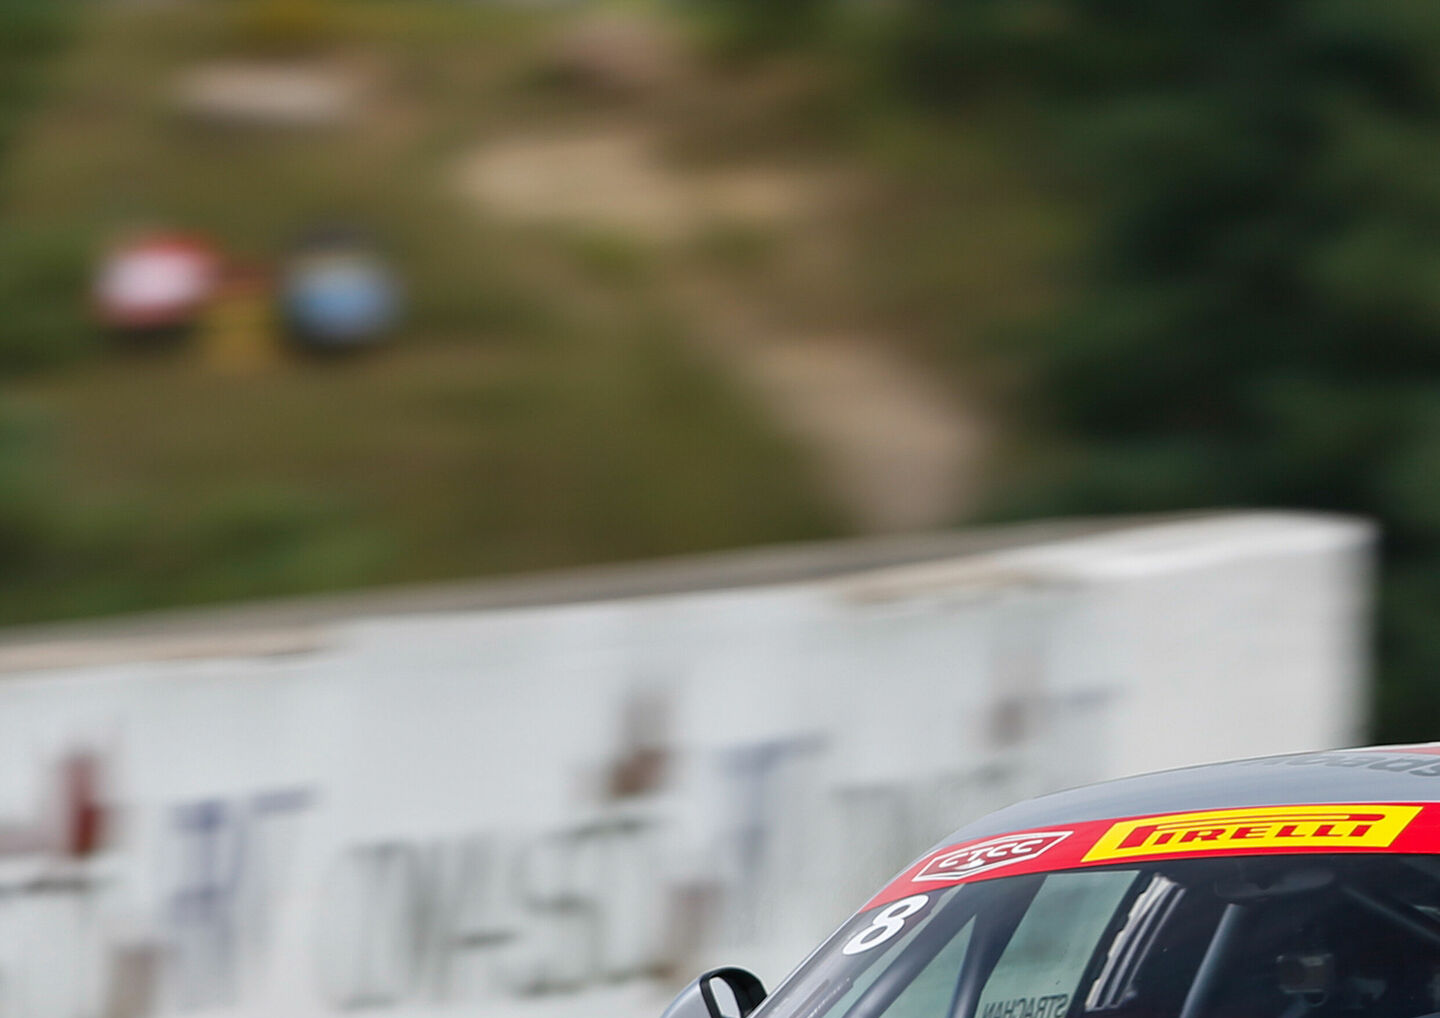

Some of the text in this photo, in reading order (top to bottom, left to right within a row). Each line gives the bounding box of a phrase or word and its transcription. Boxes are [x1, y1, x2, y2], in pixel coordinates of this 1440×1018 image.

[1116, 813, 1386, 850] PIRELLI
[938, 839, 1043, 868] CTCC
[842, 894, 929, 955] 8
